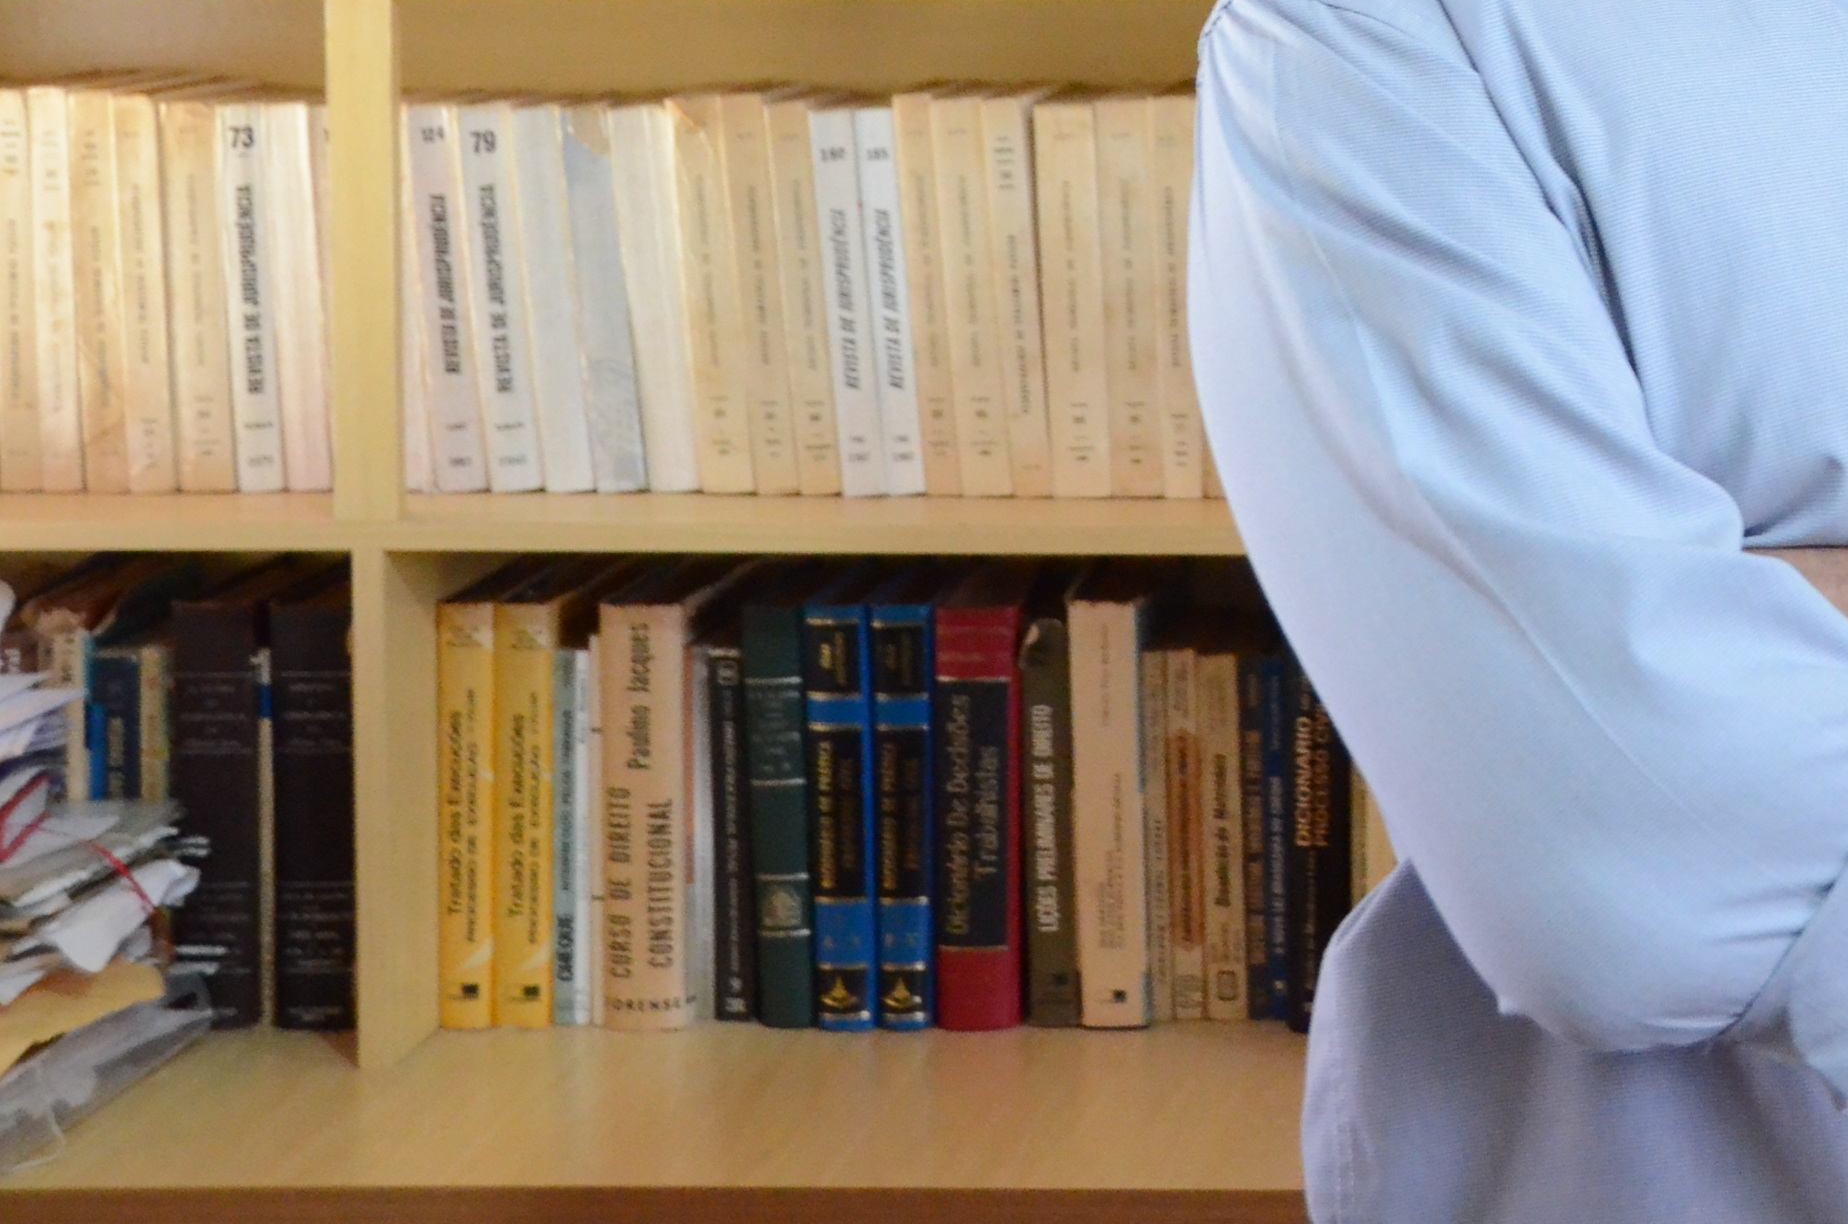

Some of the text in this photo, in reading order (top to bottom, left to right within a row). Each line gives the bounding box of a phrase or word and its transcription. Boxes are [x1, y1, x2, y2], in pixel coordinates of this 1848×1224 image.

[228, 125, 256, 148] 73
[626, 623, 653, 692] Jacques
[1030, 704, 1052, 757] DIREITO
[606, 787, 632, 978] CURSO DE DIREITO
[647, 799, 673, 968] CONSTITUCIONAL
